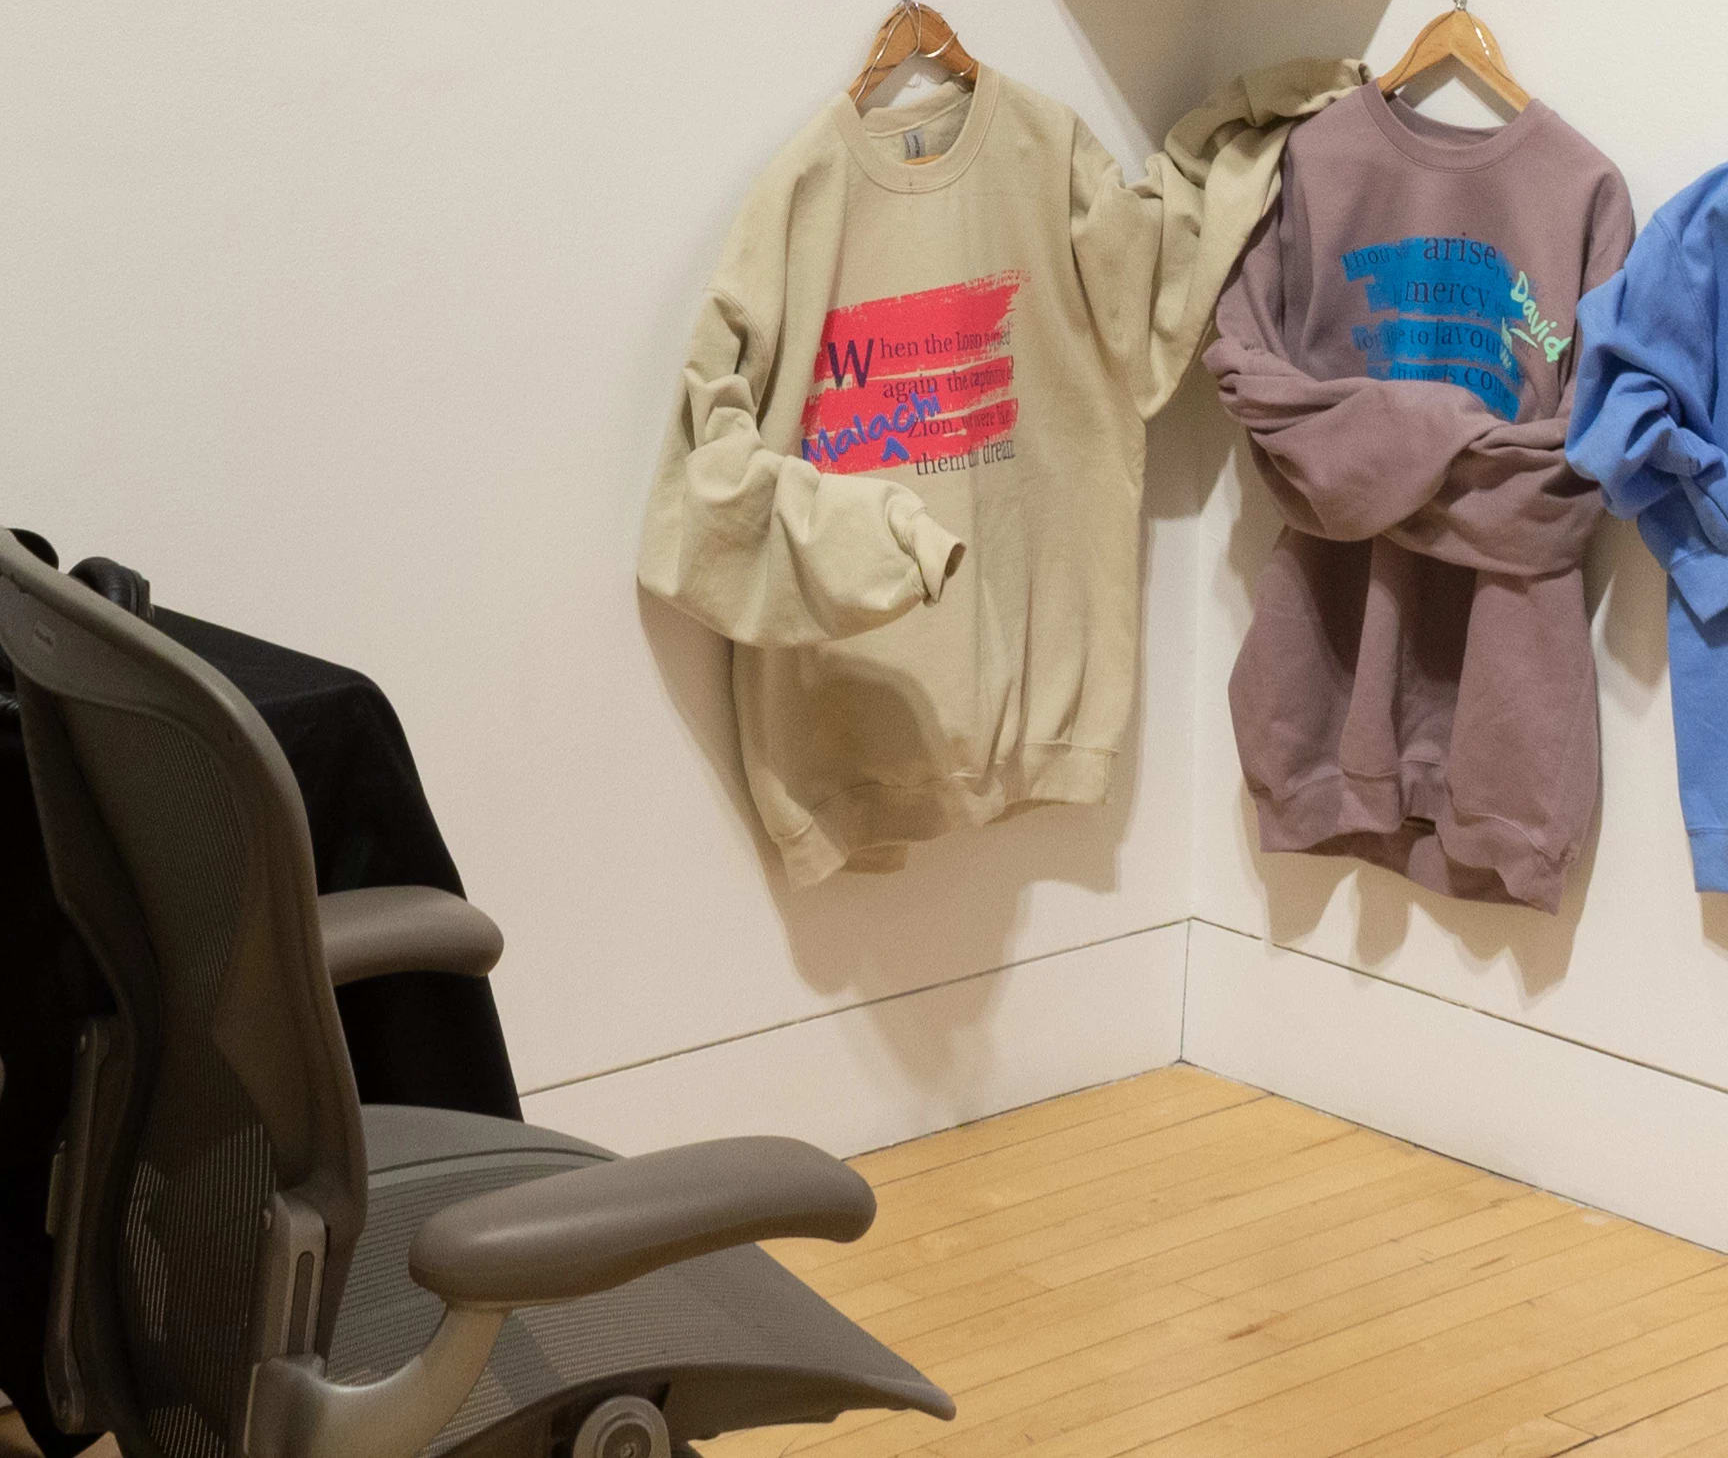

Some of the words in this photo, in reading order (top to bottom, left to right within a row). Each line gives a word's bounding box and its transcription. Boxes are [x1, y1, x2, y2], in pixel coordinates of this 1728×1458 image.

[1405, 280, 1491, 317] mercy
[1510, 270, 1572, 363] David
[828, 338, 919, 388] When
[925, 333, 953, 355] the
[883, 373, 938, 402] again
[947, 369, 968, 392] the
[801, 385, 942, 463] Malachi
[915, 451, 966, 476] them
